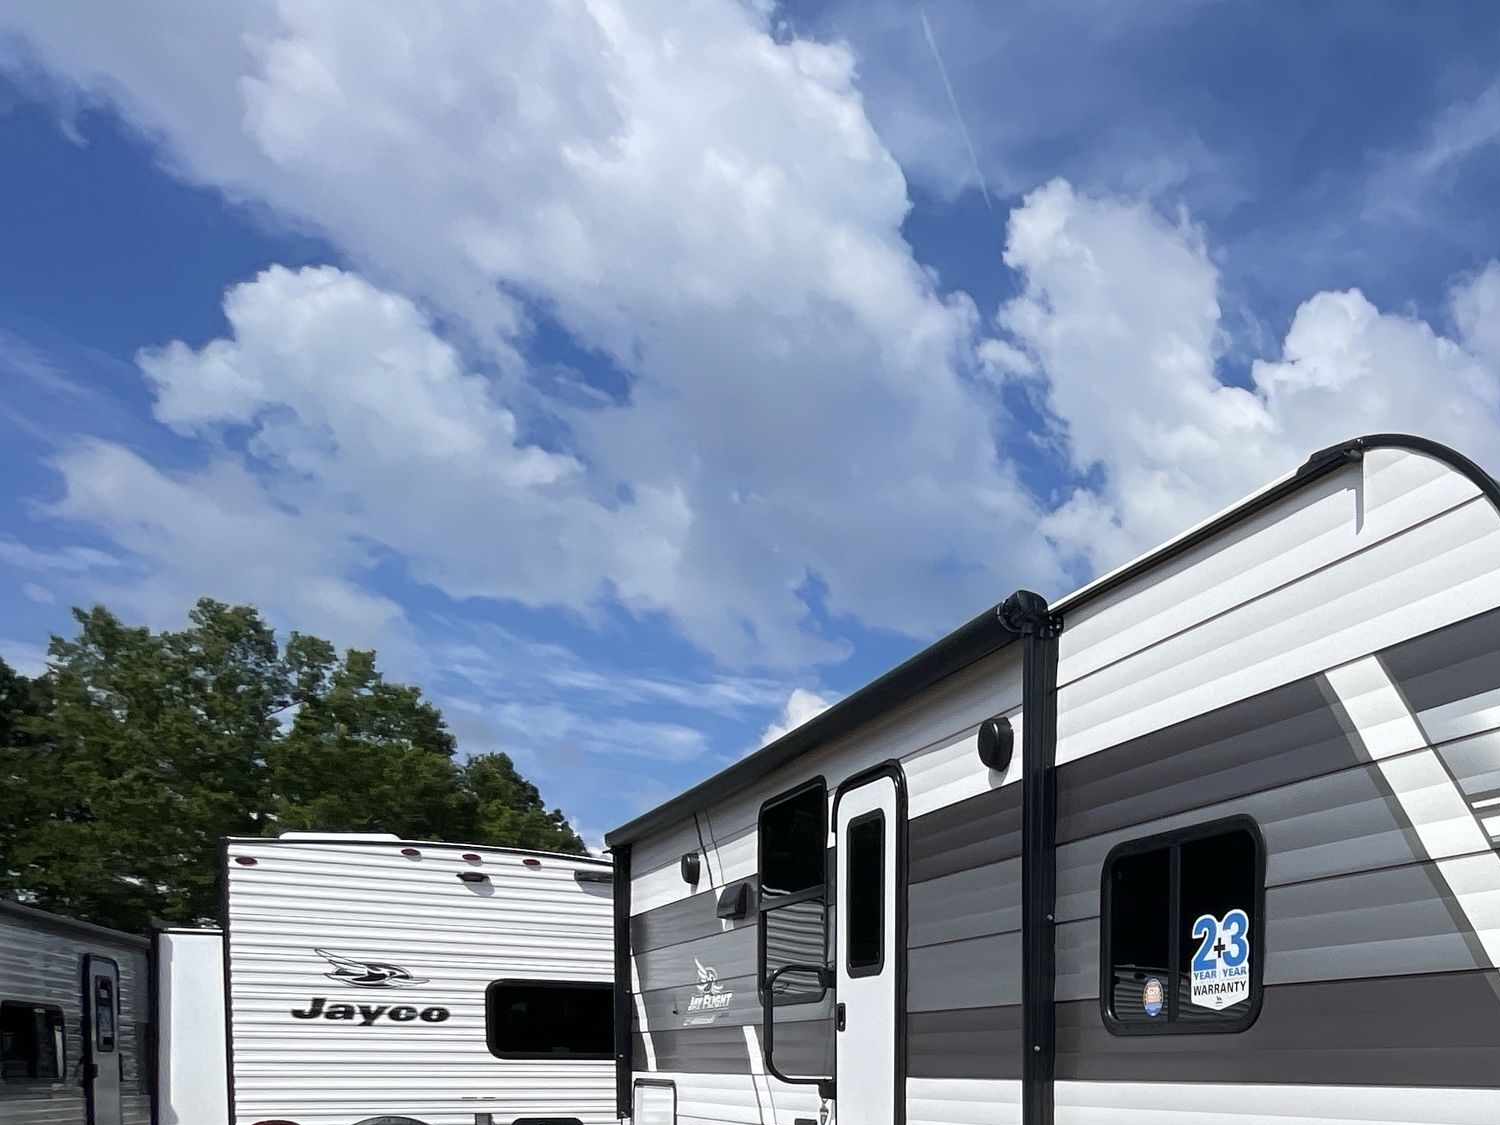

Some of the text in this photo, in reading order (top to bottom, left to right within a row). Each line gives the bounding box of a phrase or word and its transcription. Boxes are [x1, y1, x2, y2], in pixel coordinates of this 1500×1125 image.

[1193, 970, 1217, 981] YEAR
[1222, 966, 1247, 977] YEAR
[1193, 980, 1247, 997] WARRANTY
[290, 997, 450, 1026] Jayco
